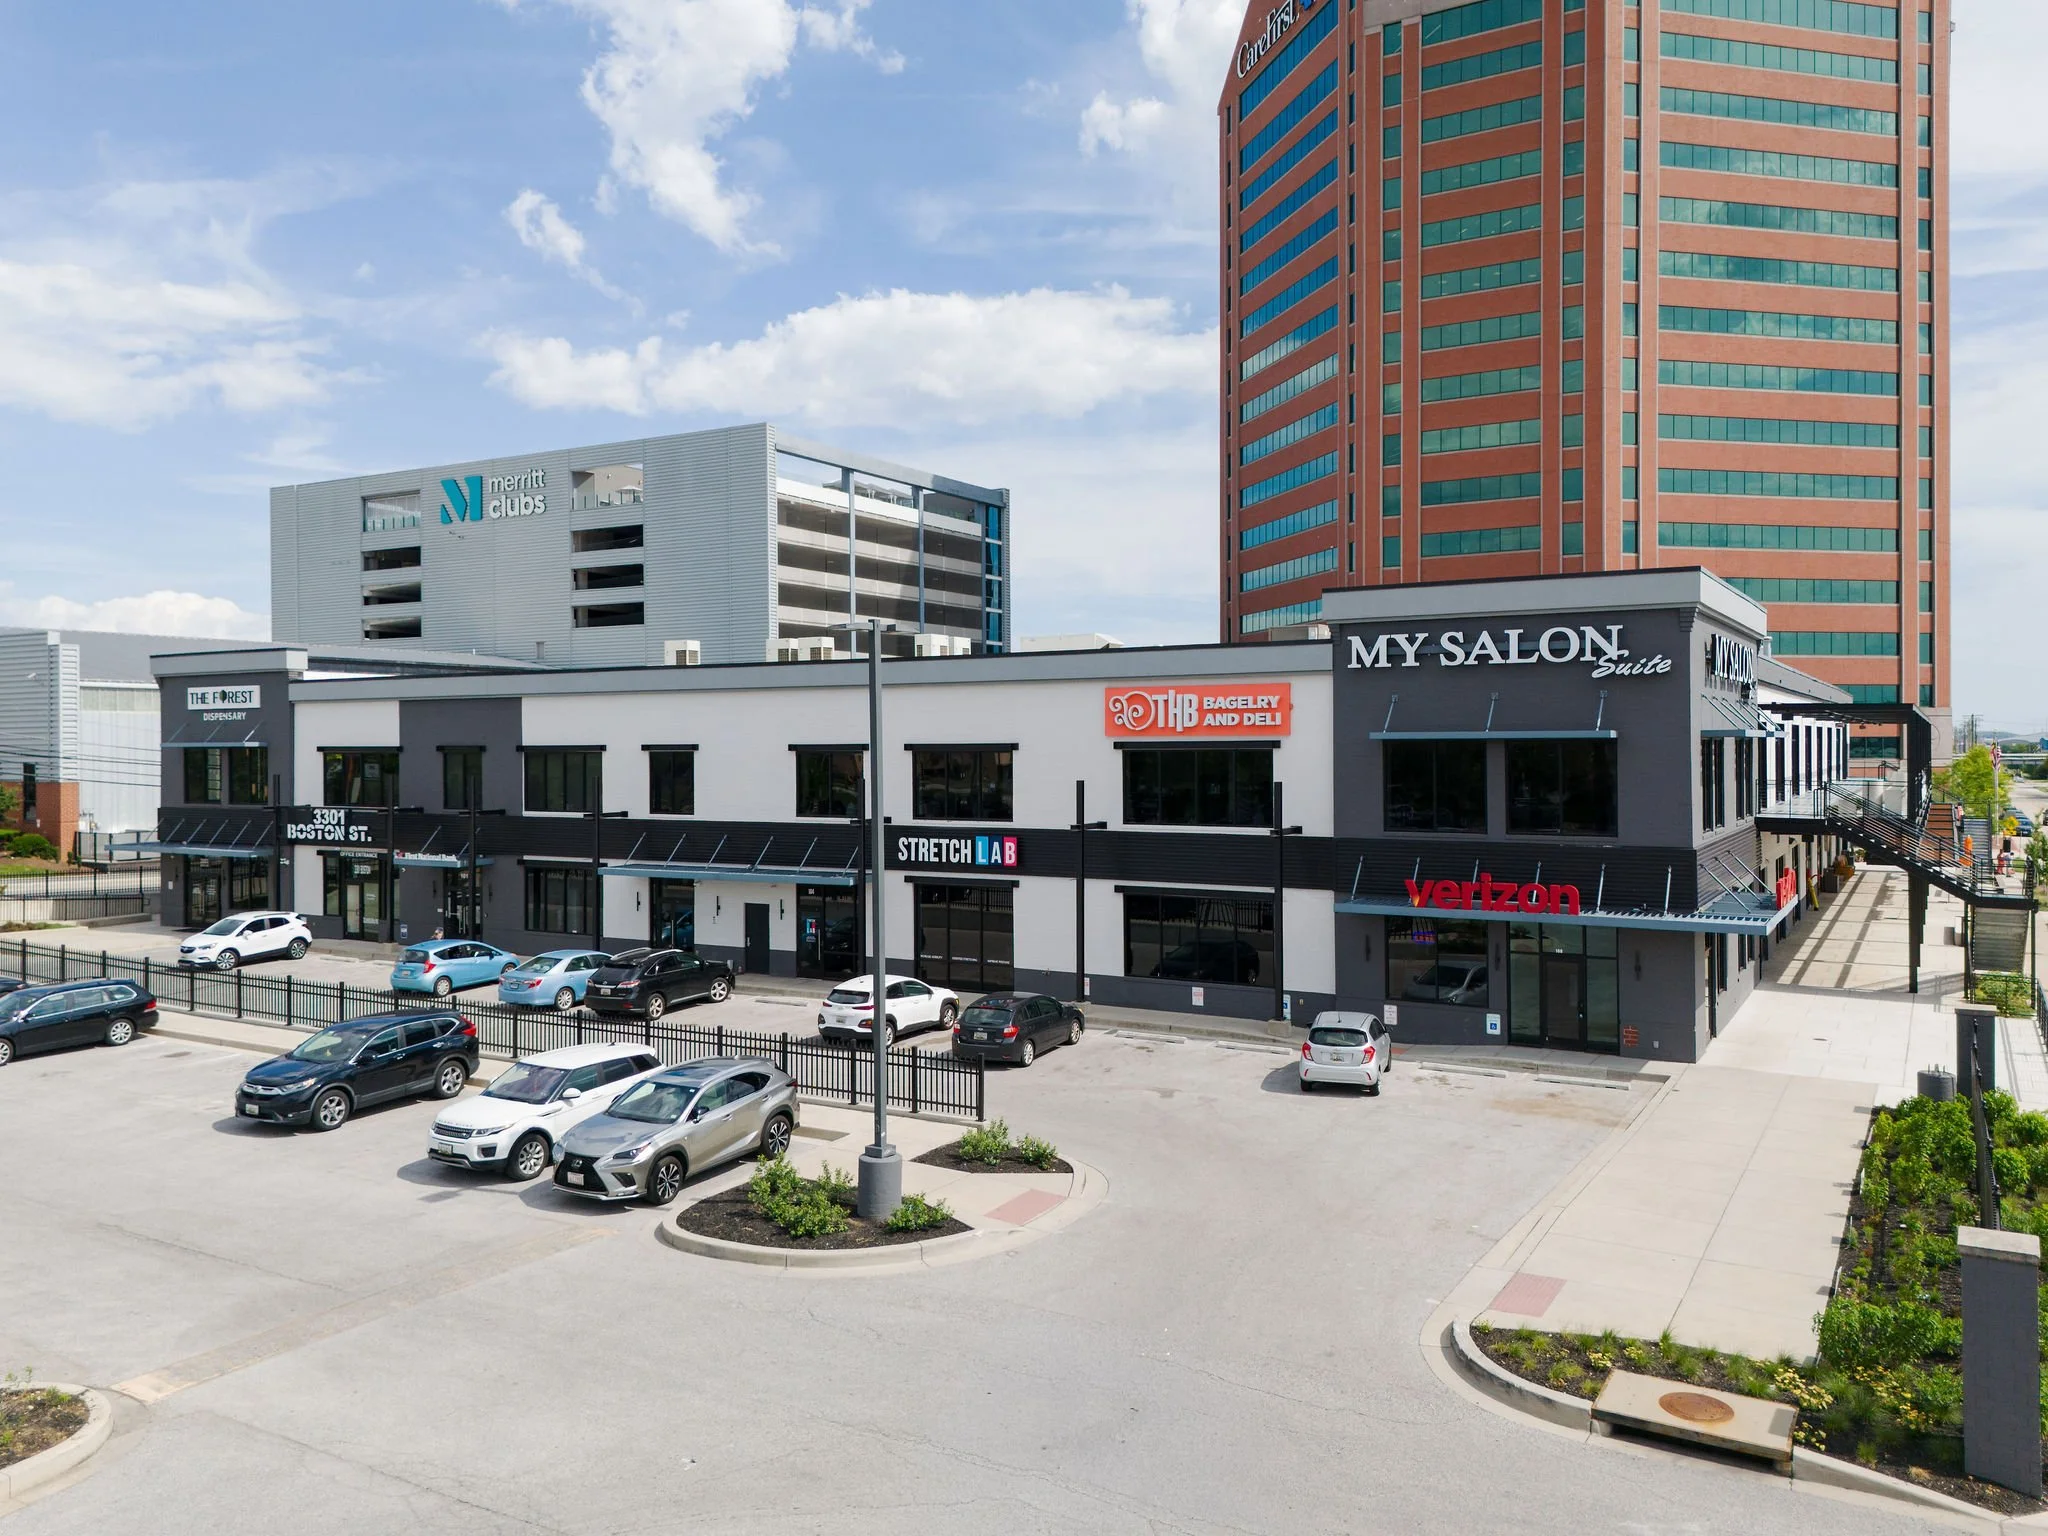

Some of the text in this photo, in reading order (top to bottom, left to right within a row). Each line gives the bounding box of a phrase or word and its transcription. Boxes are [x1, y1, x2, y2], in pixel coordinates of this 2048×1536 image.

[1237, 0, 1296, 78] CareFirst
[489, 468, 545, 493] merritt
[489, 492, 546, 519] clubs
[1347, 625, 1624, 669] MY SALON
[1591, 649, 1672, 679] Suite
[190, 689, 254, 705] THE FOREST
[1203, 695, 1281, 710] BAGELRY
[203, 711, 247, 721] DISPENSARY
[1152, 689, 1199, 732] THB
[1203, 711, 1282, 727] AND DELI
[313, 808, 345, 825] 3301
[287, 823, 372, 842] BOSTON ST.
[898, 837, 972, 864] STRETCH
[1404, 872, 1581, 916] verizon
